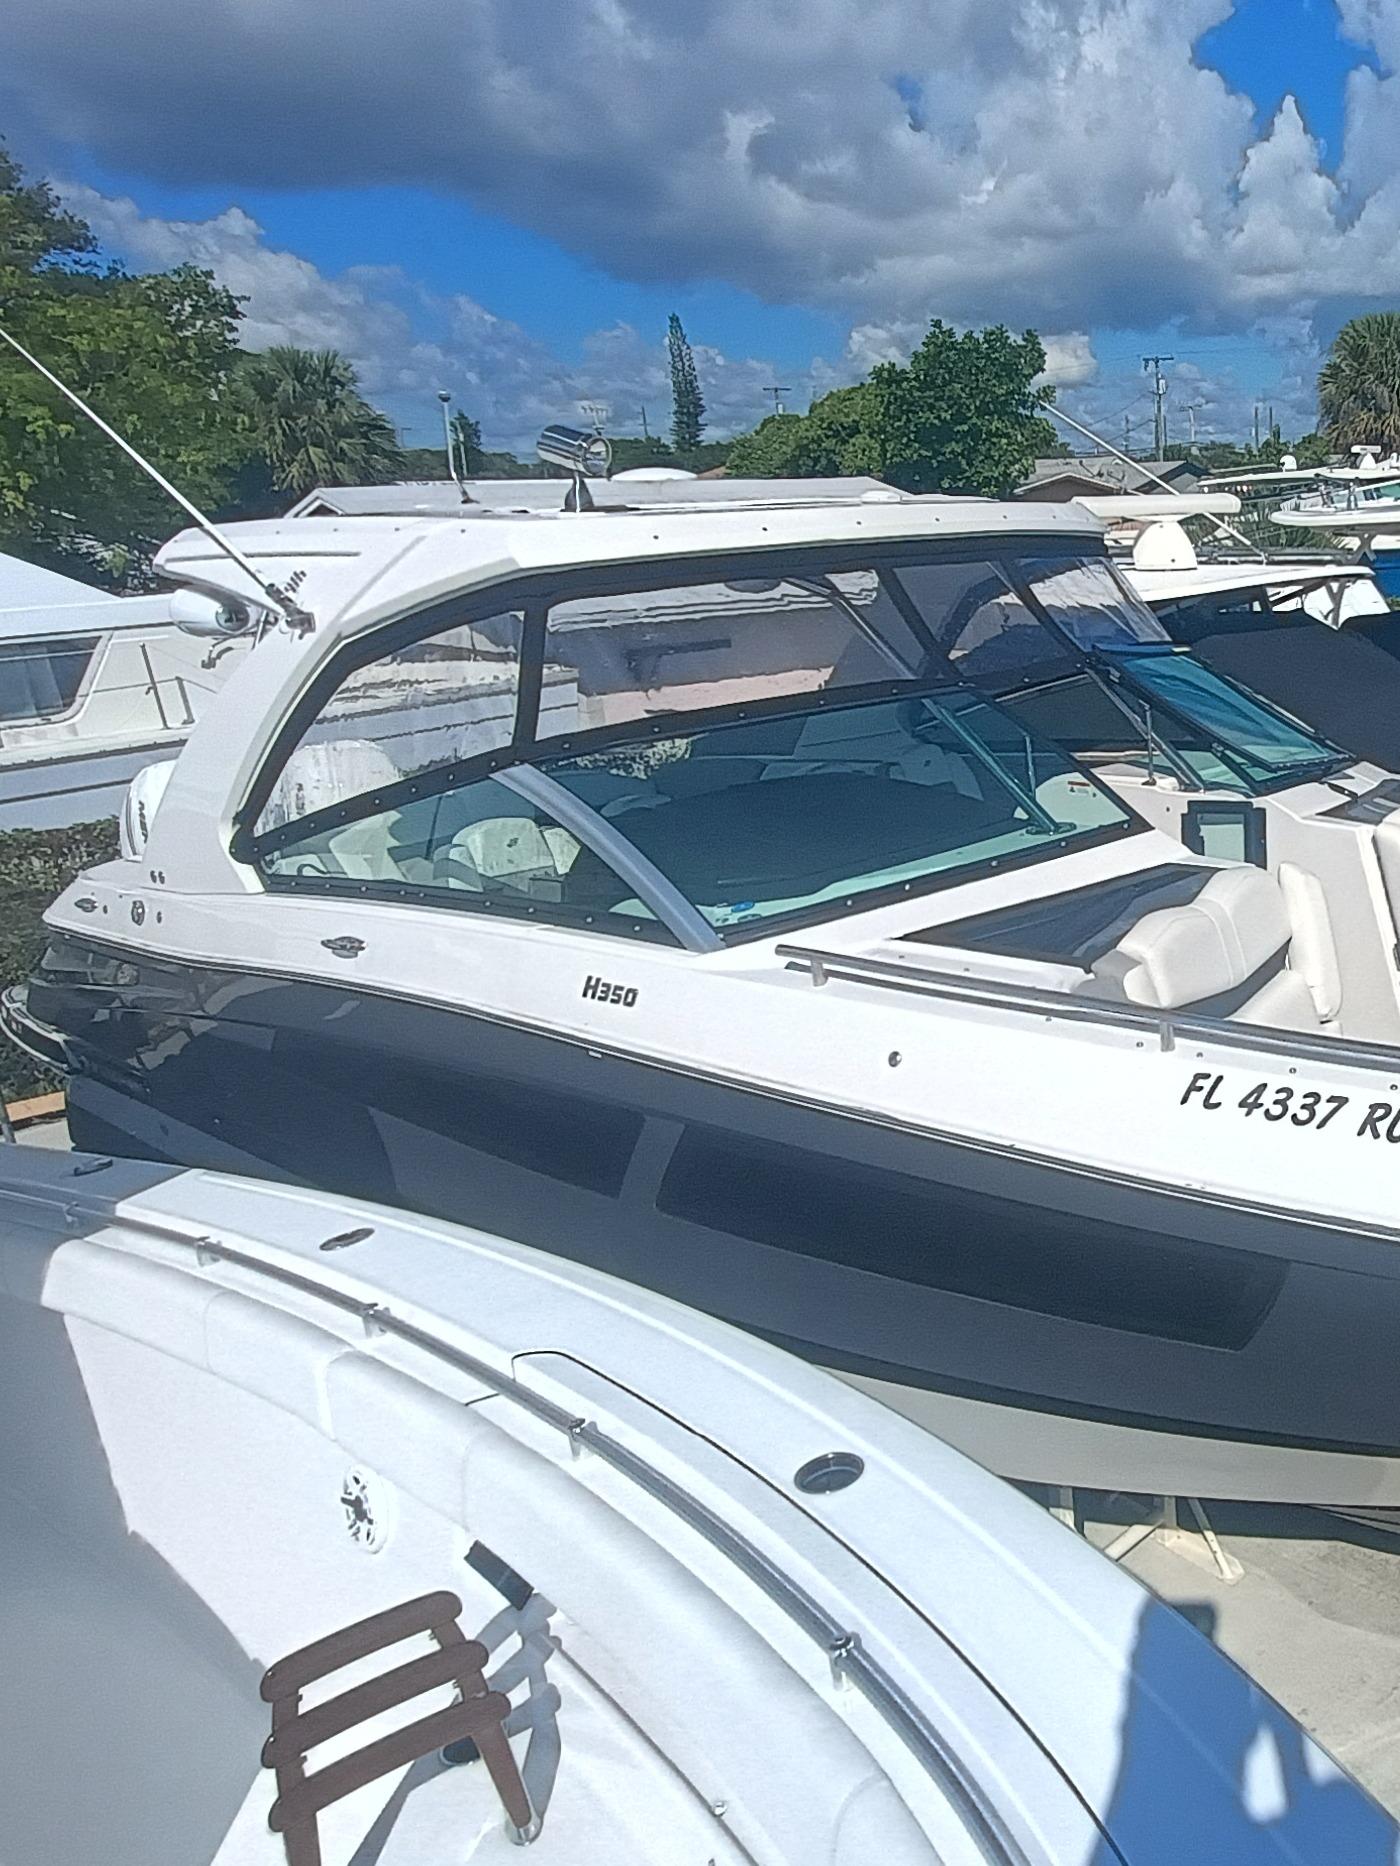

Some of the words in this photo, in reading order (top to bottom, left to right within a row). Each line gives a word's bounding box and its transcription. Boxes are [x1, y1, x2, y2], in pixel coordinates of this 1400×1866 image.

[581, 974, 639, 1008] H350
[1180, 1072, 1224, 1110] FL
[1238, 1082, 1349, 1130] 4337
